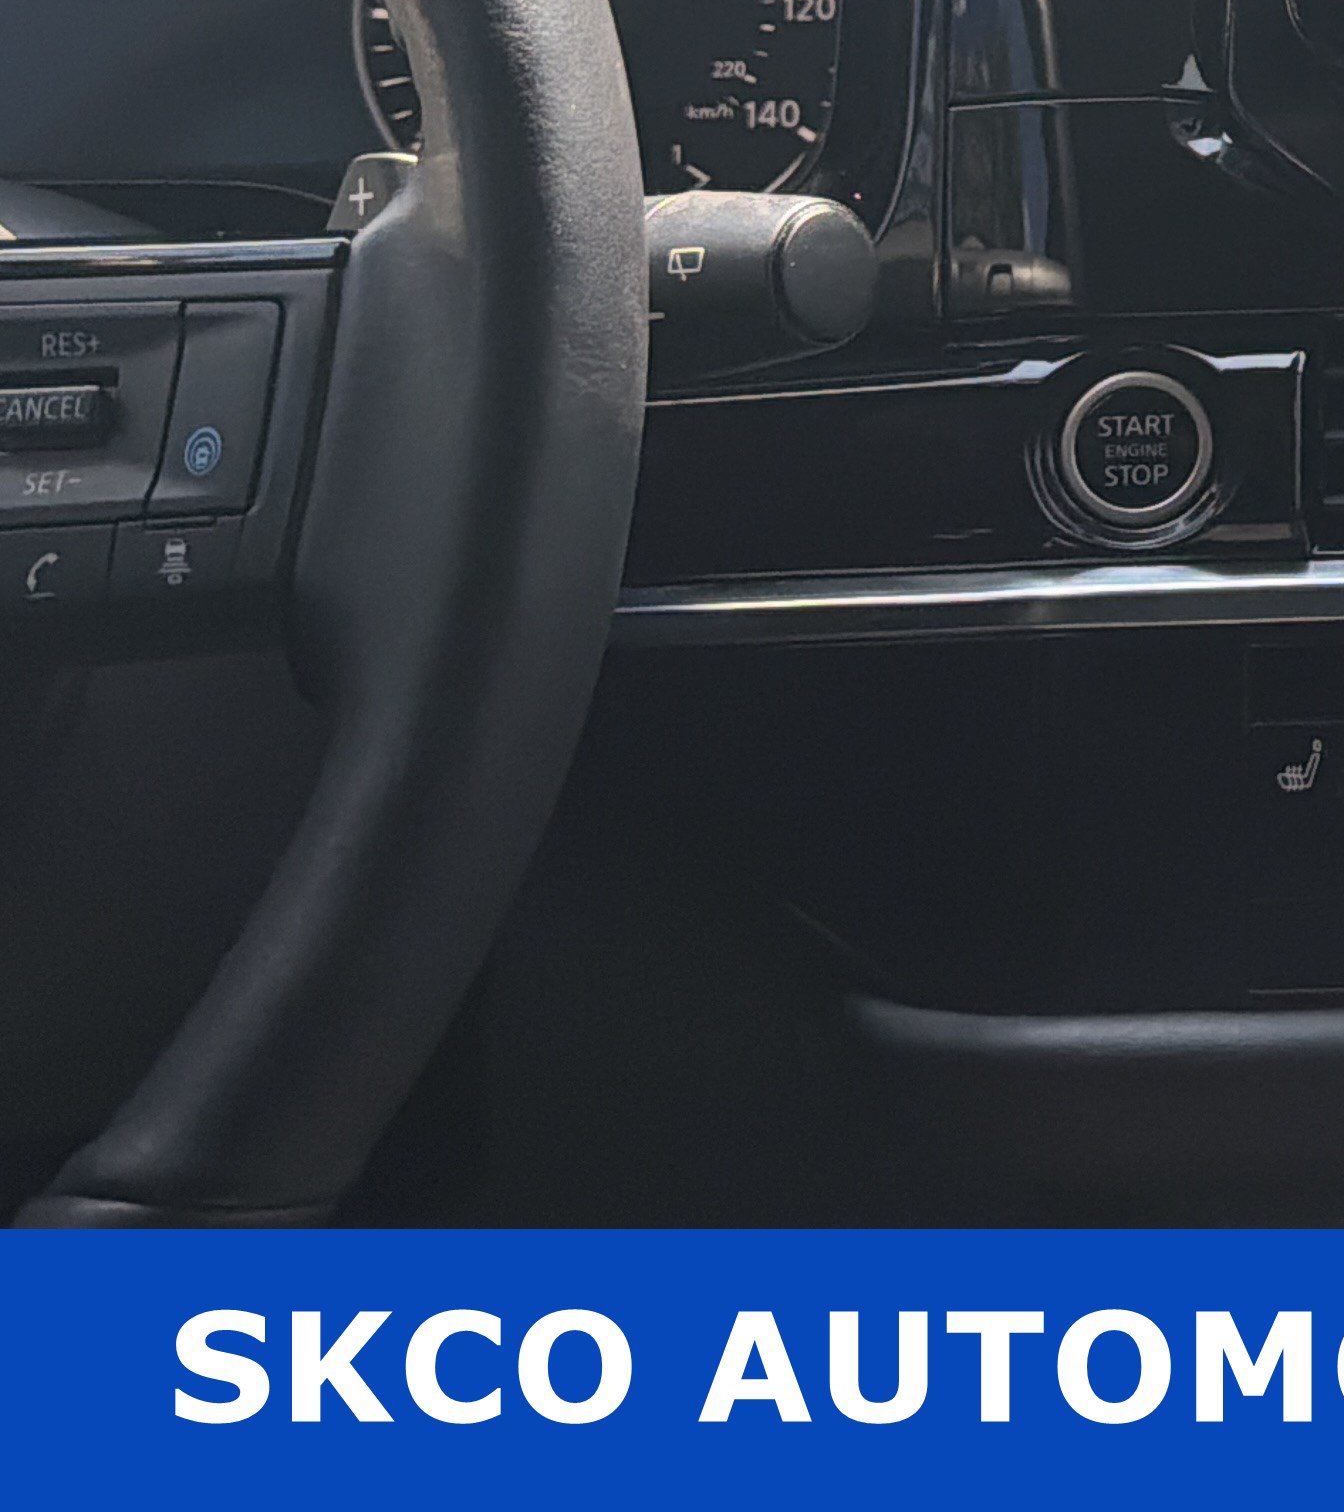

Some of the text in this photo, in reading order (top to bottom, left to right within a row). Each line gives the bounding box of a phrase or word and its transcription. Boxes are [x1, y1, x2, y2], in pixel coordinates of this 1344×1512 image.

[711, 60, 747, 79] 220
[686, 103, 734, 120] km/h
[744, 99, 800, 129] 140
[41, 332, 101, 357] RES+
[1097, 414, 1175, 437] START
[1105, 443, 1168, 459] ENGINE
[1105, 464, 1169, 487] STOP
